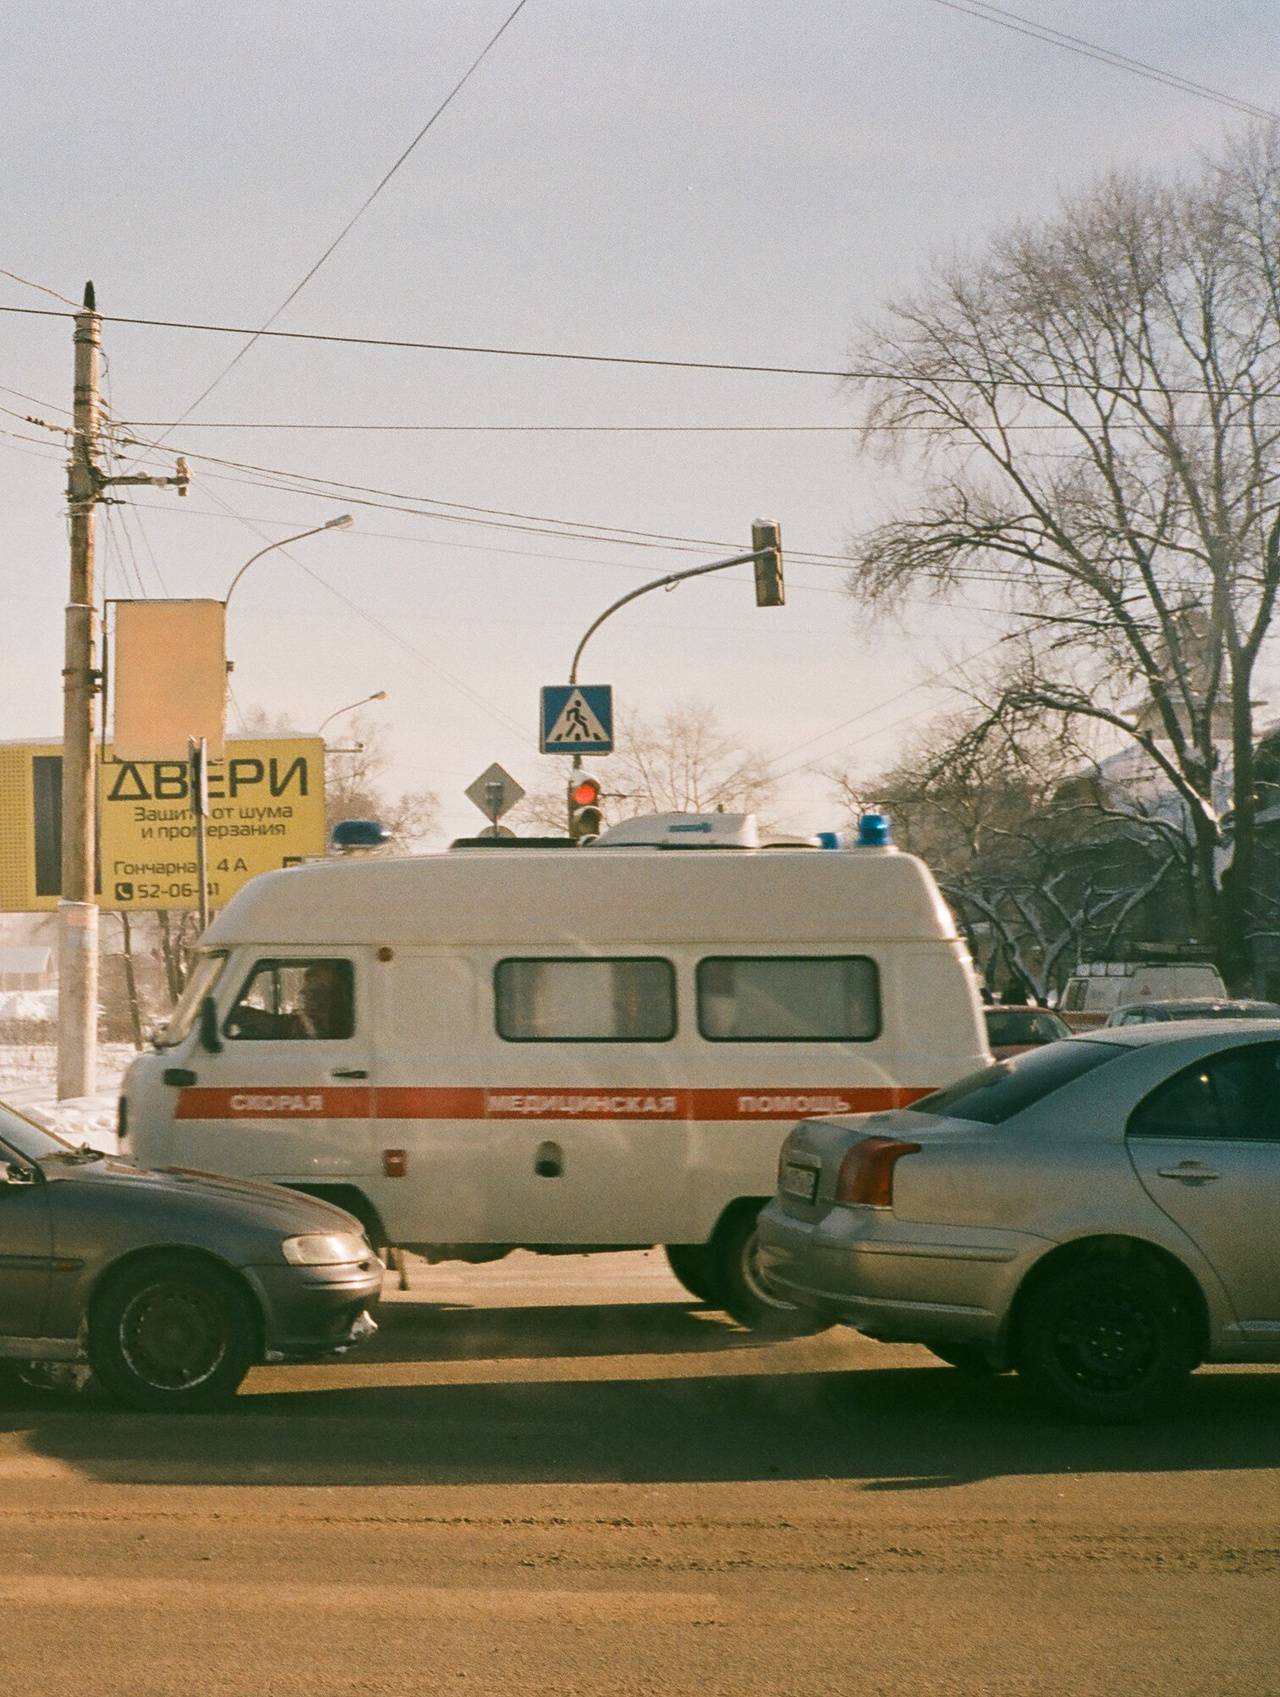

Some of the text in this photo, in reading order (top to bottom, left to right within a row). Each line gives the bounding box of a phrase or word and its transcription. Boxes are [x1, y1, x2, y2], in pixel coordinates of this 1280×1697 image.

[107, 757, 308, 801] ДВЕРИ
[134, 806, 293, 822] Защит от шума
[141, 827, 153, 839] и
[114, 861, 204, 876] Гончарна
[216, 858, 230, 873] 4
[230, 1094, 852, 1114] СКОРАЯ МЕДИЦИНСКАЯ ПОМОЩЬ
